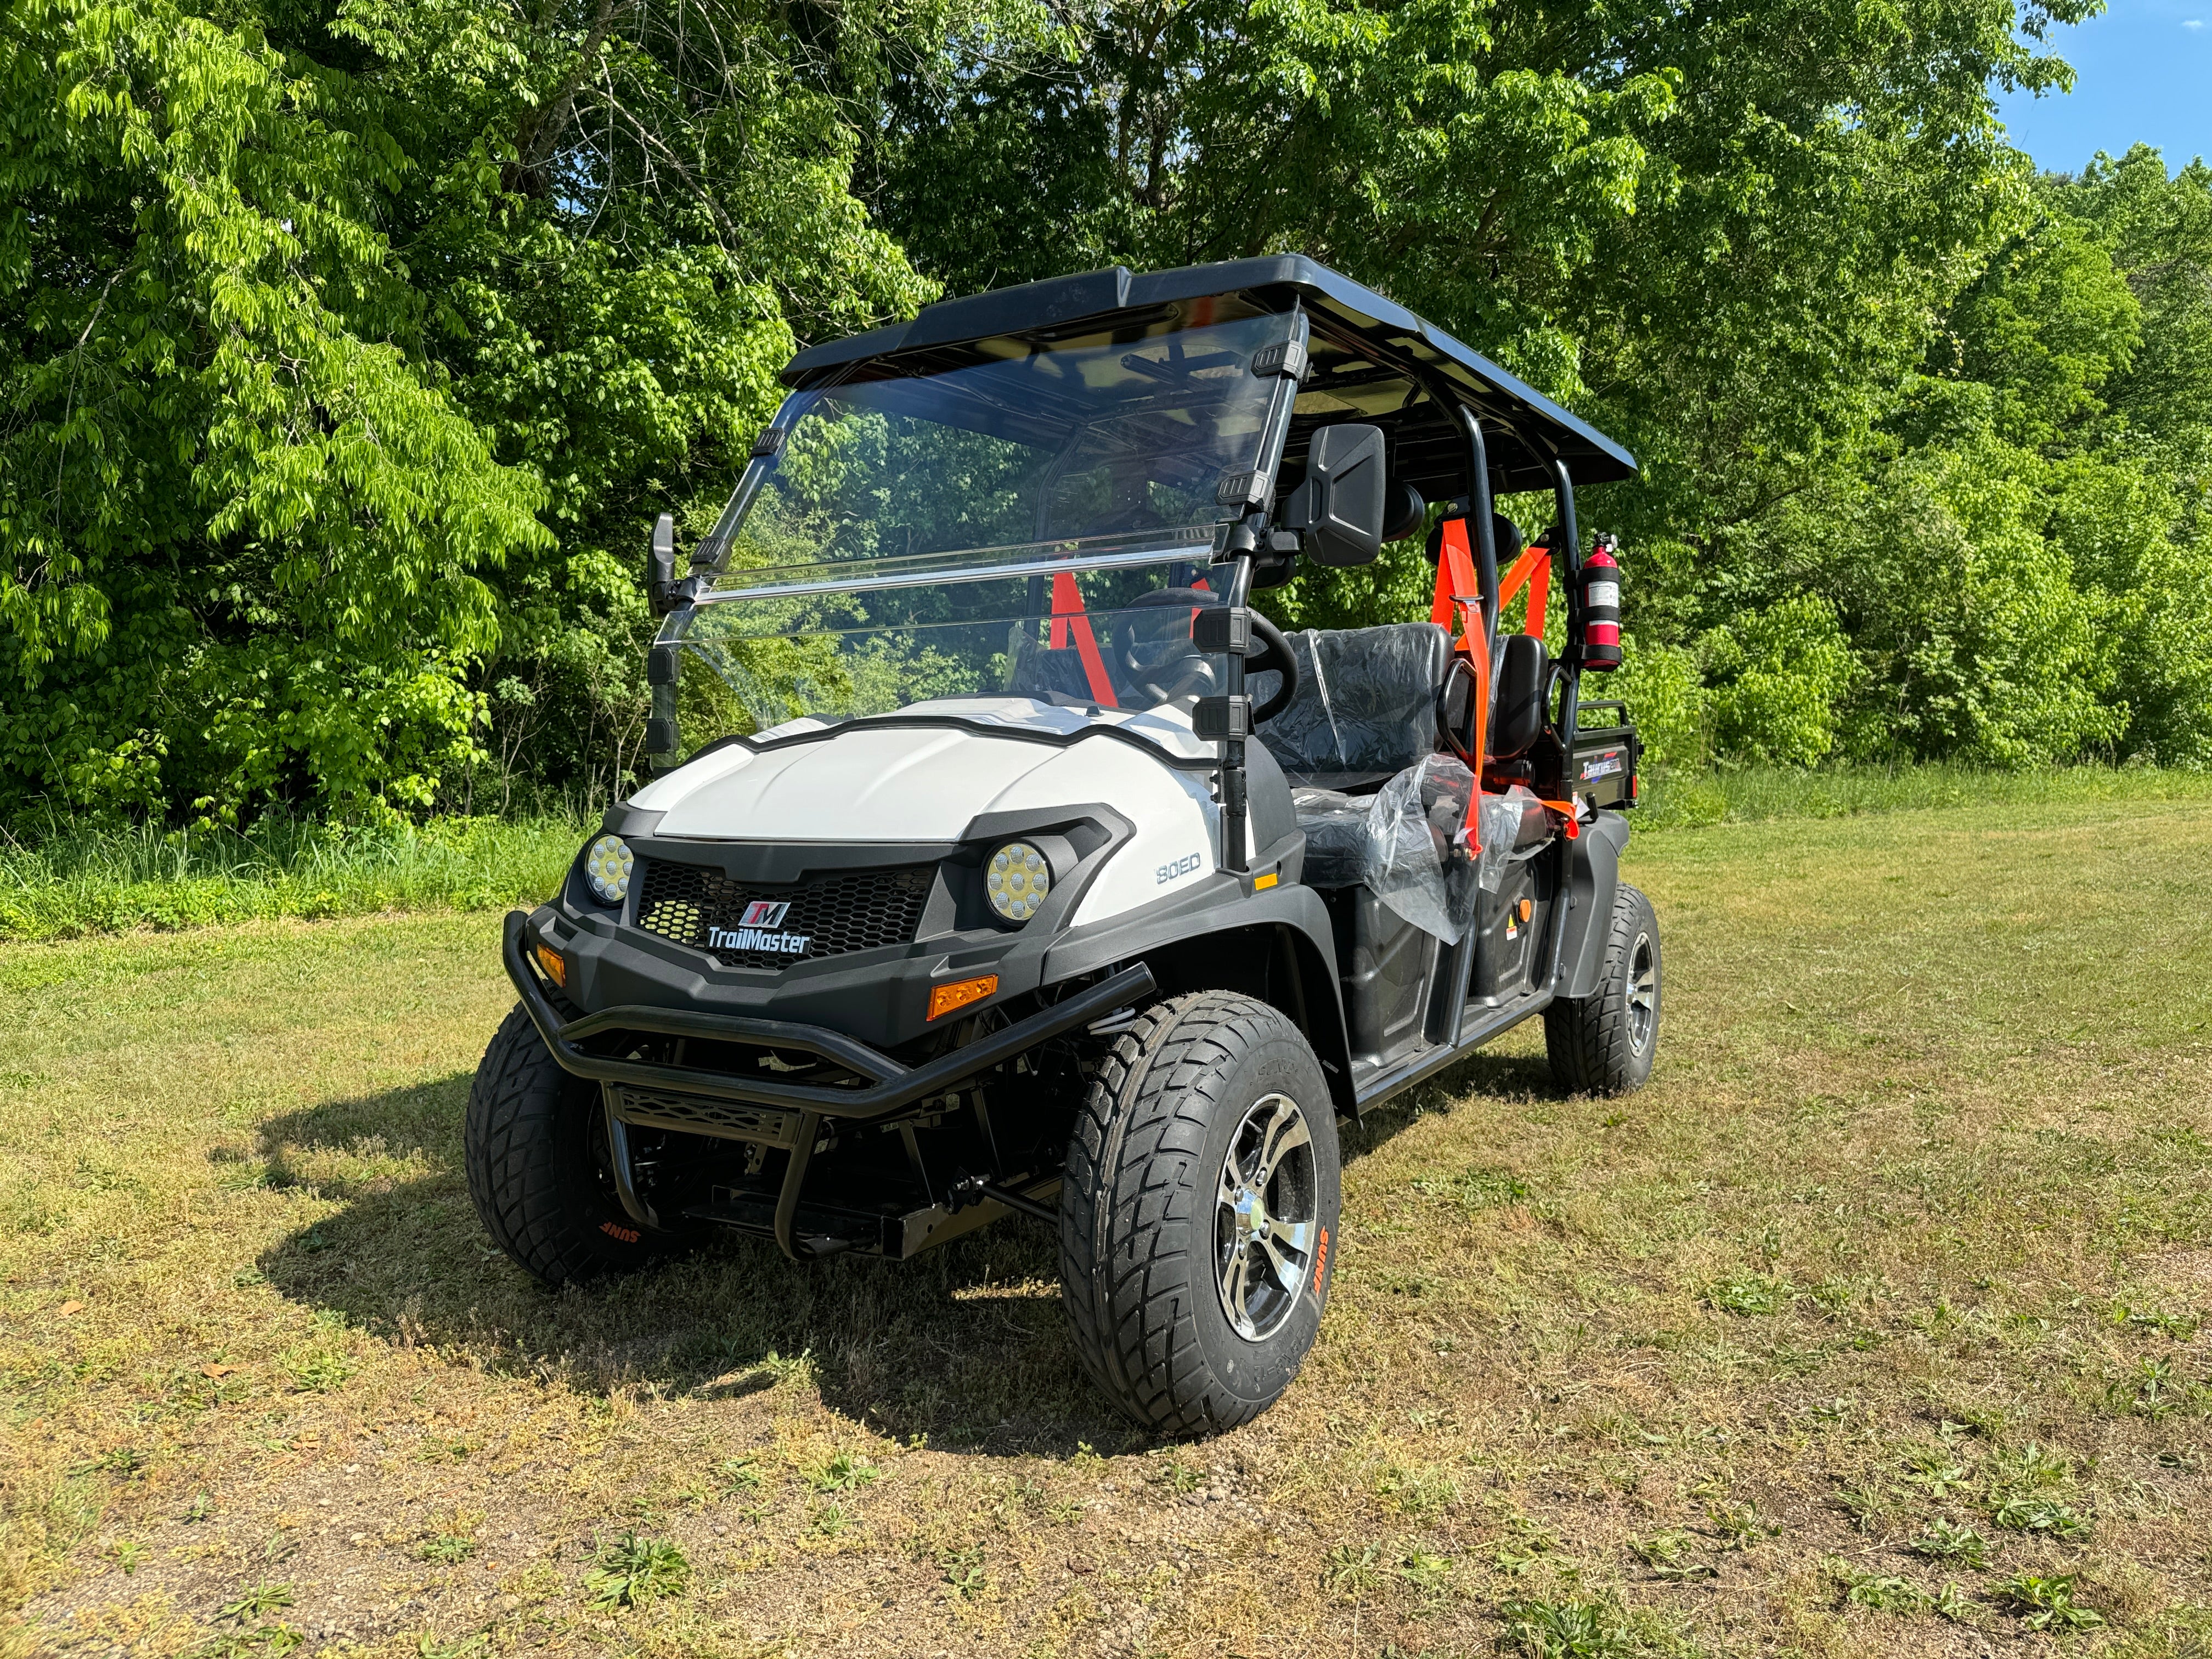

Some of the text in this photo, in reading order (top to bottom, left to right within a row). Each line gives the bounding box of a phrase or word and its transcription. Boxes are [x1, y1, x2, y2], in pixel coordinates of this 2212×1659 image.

[1583, 760, 1610, 777] Taurus
[1156, 853, 1200, 884] 80ED
[746, 902, 788, 926] TM
[709, 927, 810, 953] TrailMaster
